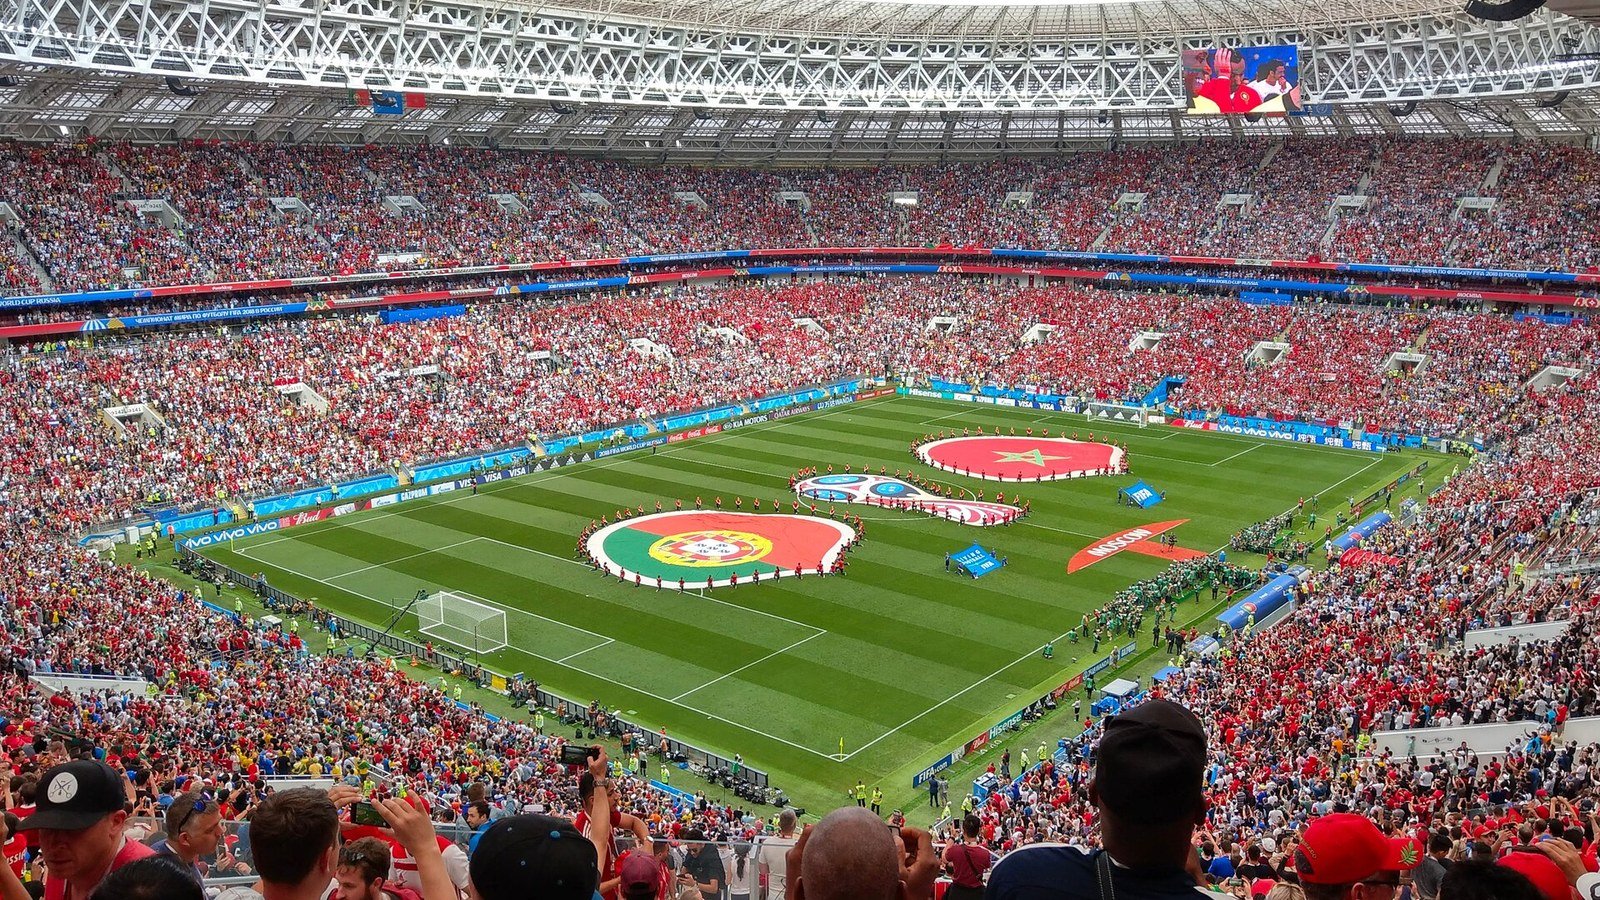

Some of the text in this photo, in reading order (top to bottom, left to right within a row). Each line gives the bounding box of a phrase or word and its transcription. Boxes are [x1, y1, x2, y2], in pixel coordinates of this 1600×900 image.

[36, 297, 61, 305] RUSSIA
[909, 388, 942, 398] Hisense
[1018, 400, 1033, 408] VISA
[1039, 402, 1055, 410] VISA
[1060, 405, 1076, 413] VISA
[733, 420, 744, 428] KIA
[744, 414, 768, 425] MOTORS
[774, 410, 791, 419] QATAR
[1183, 420, 1205, 429] Bud
[610, 447, 620, 455] FIFA
[620, 444, 637, 453] WORLD
[484, 472, 502, 483] VISA
[508, 466, 526, 477] VISA
[1132, 488, 1153, 502] FIFA
[293, 509, 320, 525] Bud
[1086, 528, 1152, 556] MOSCOW
[981, 561, 994, 570] FIFA
[989, 713, 1022, 739] Hisense
